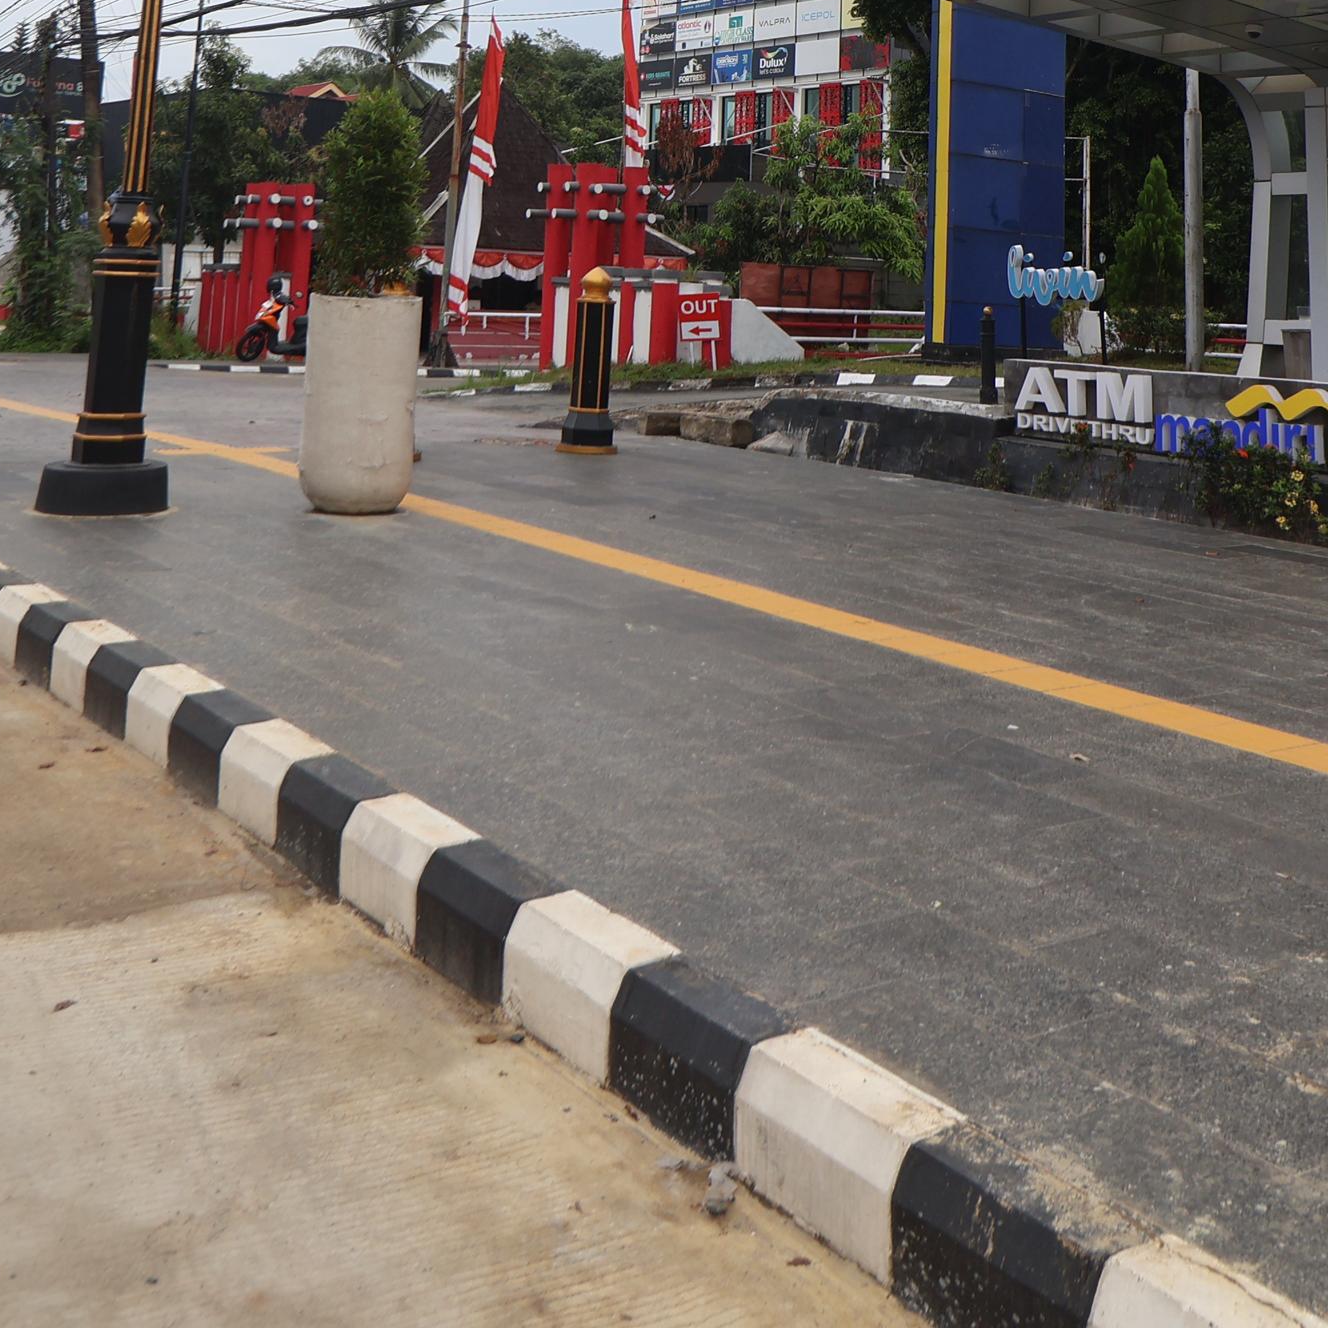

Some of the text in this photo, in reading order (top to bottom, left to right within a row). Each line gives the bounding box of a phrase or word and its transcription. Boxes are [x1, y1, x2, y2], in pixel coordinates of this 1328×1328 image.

[801, 10, 835, 22] ICEPOL
[677, 21, 702, 30] atlantic
[759, 17, 791, 27] VALPRA
[760, 57, 784, 68] Dulux
[678, 73, 706, 83] FORTRESS
[681, 299, 718, 314] OUT
[1015, 366, 1154, 423] ATM
[1087, 420, 1155, 446] THRU
